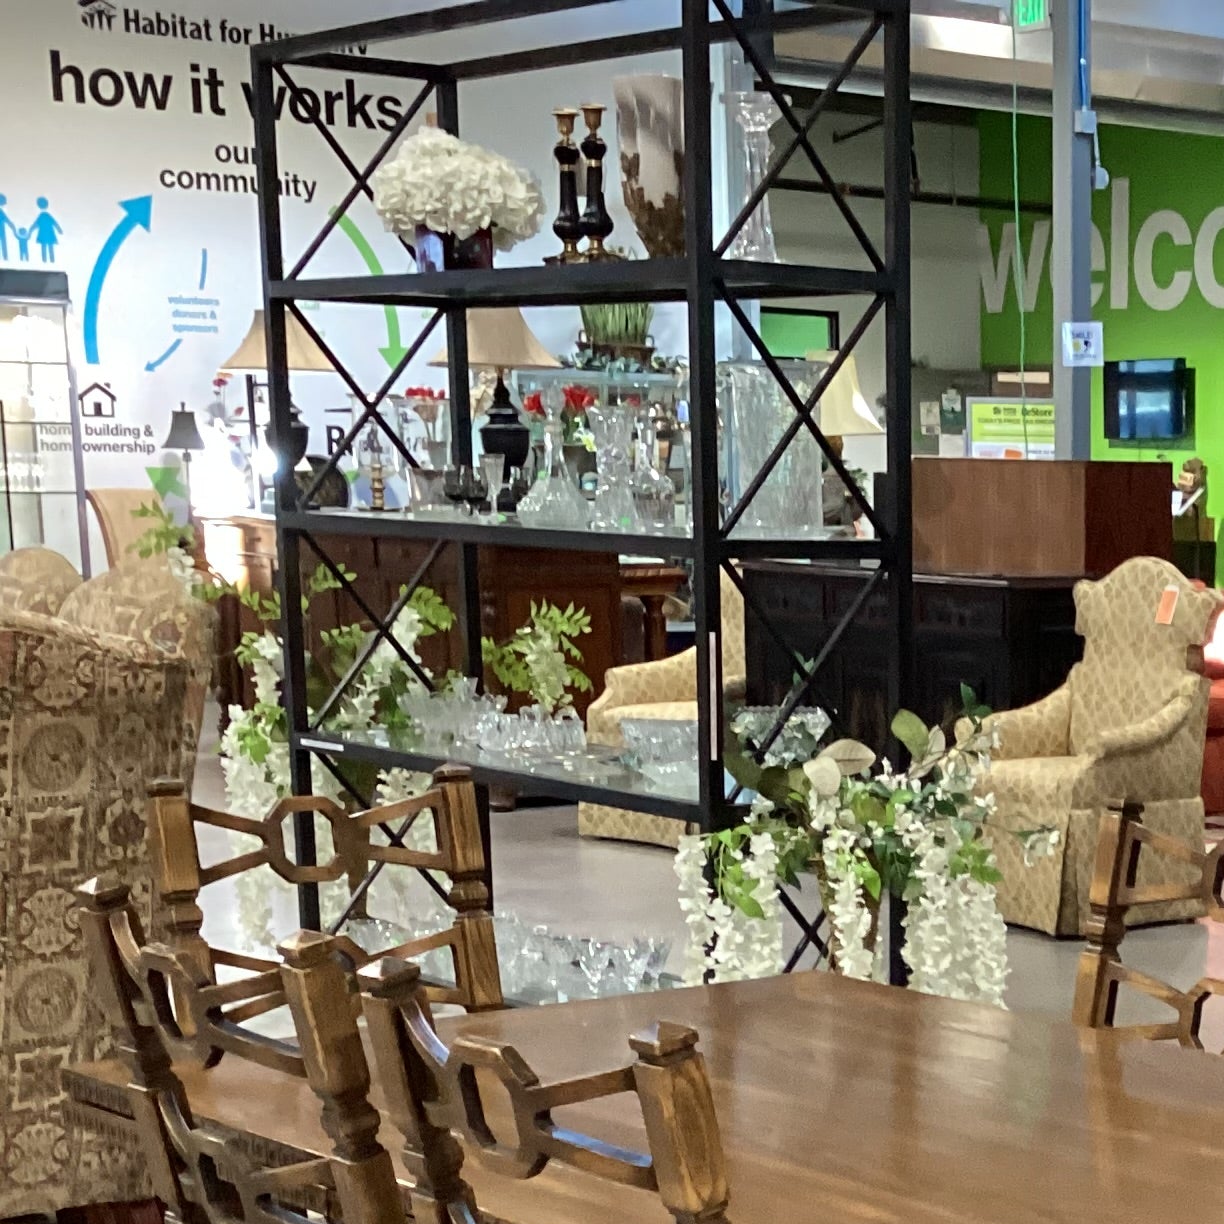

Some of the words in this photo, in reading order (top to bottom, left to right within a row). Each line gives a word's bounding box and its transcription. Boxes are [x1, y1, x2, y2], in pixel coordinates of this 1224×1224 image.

[123, 8, 213, 42] Habitat
[220, 19, 254, 45] for
[49, 49, 173, 111] how
[189, 63, 227, 117] it
[240, 78, 404, 133] works
[40, 424, 72, 435] hom
[85, 424, 141, 439] building
[143, 424, 154, 437] &
[40, 439, 156, 455] homownership
